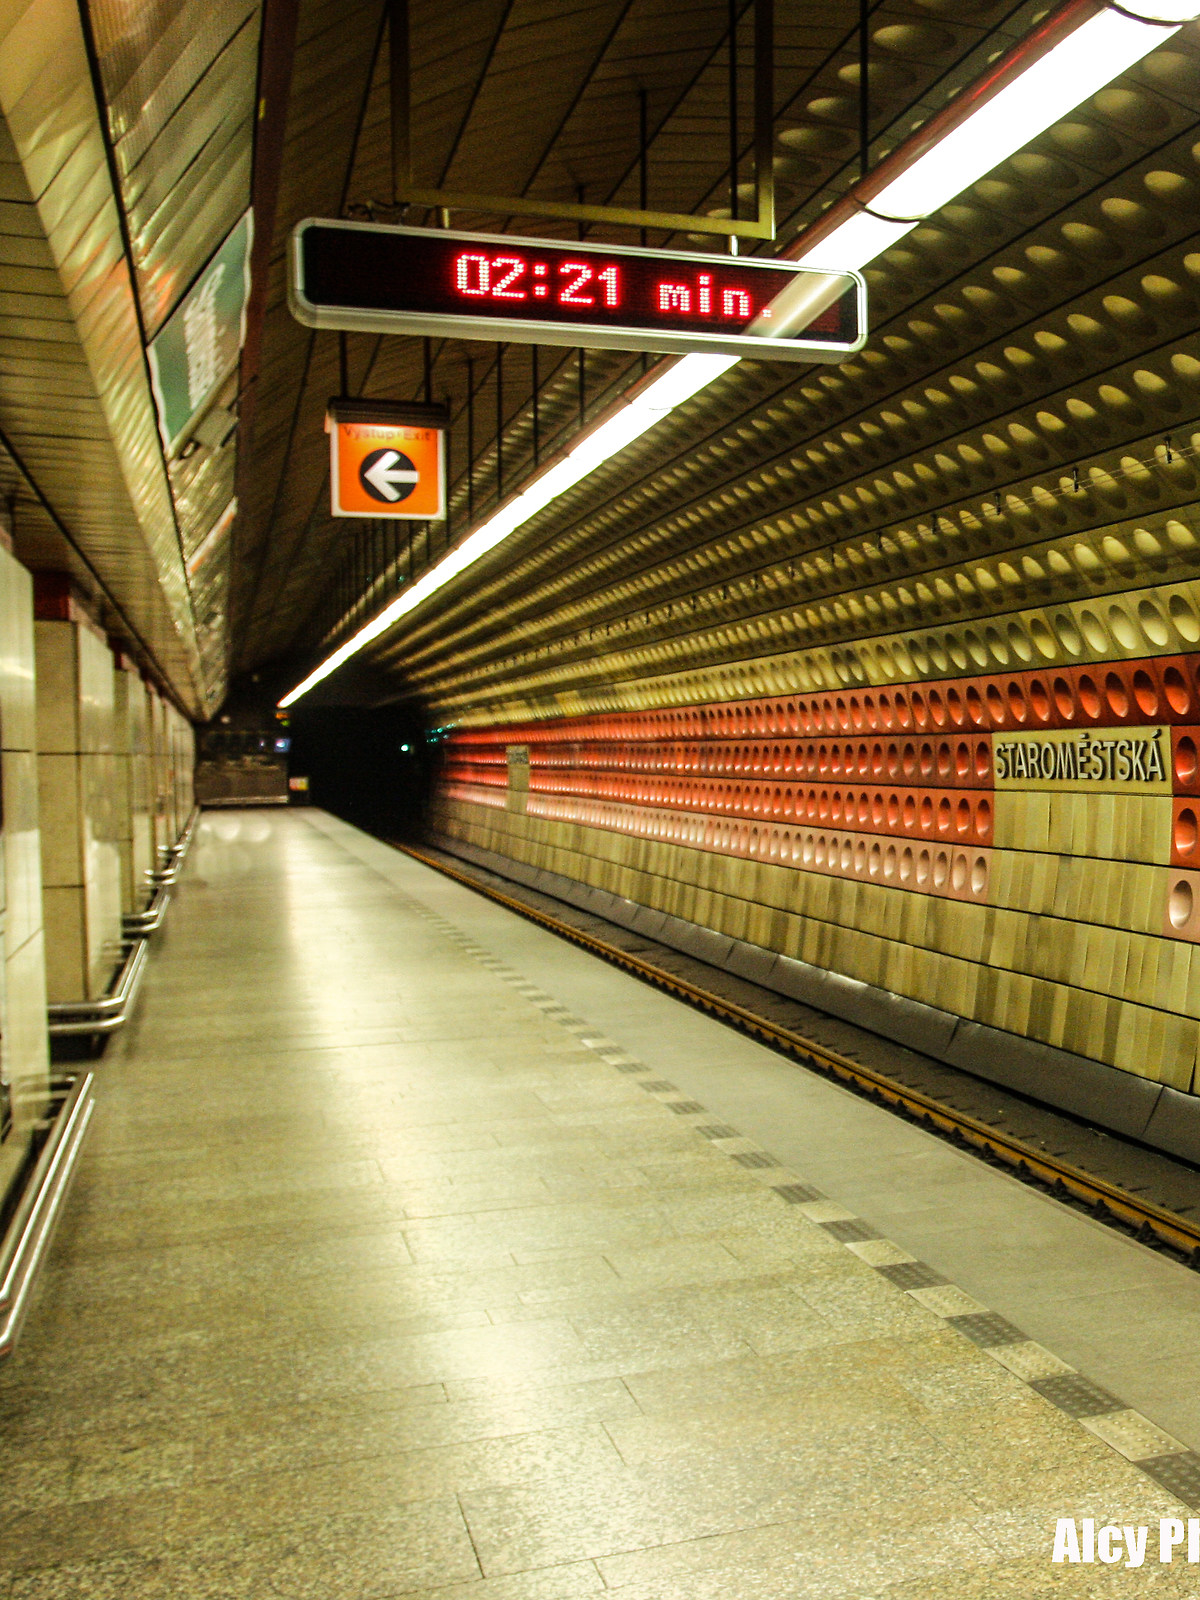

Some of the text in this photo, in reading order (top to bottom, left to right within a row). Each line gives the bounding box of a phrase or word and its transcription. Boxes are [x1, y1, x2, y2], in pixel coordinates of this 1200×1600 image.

[455, 253, 773, 319] 02:21 min.
[994, 728, 1167, 782] STAROMĚSTSKÁ
